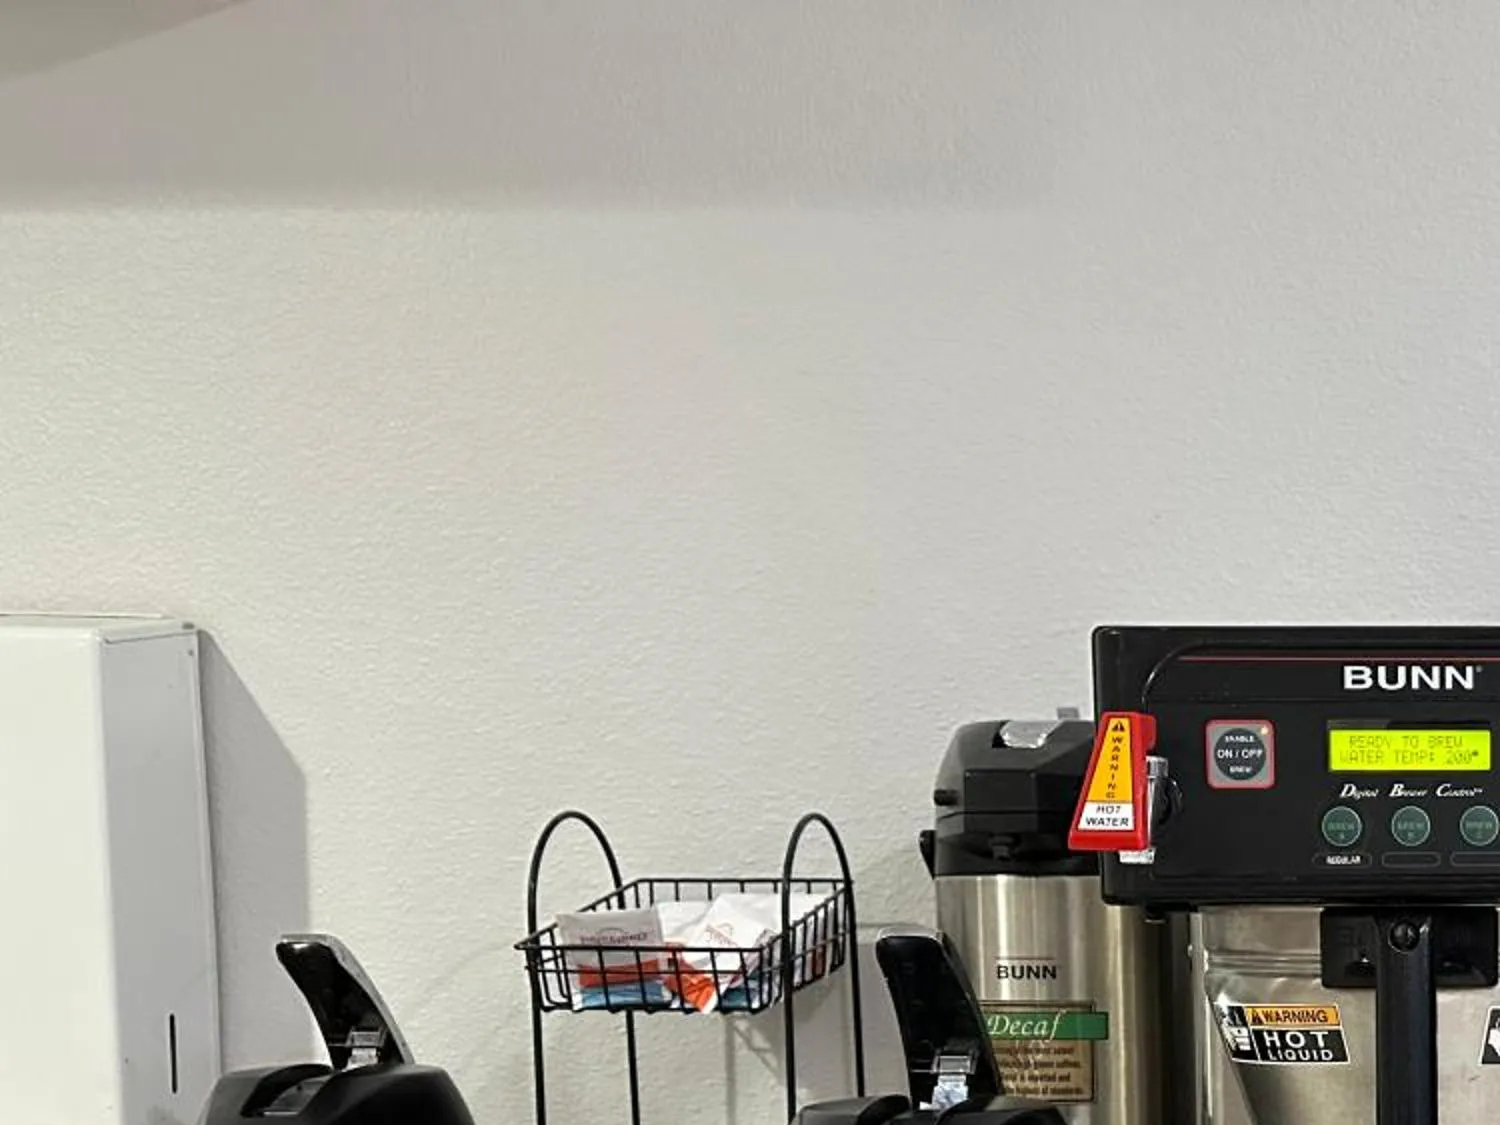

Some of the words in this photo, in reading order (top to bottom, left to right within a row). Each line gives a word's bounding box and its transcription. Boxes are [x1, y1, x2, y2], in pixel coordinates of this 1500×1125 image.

[1343, 665, 1474, 690] BUNN
[1349, 735, 1392, 749] READY
[1401, 735, 1419, 749] TO
[1427, 735, 1463, 749] BREW
[1217, 749, 1233, 758] ON
[1241, 749, 1263, 758] OFF
[1339, 750, 1384, 765] WATER
[1393, 750, 1435, 765] TEMP:
[1105, 736, 1124, 799] WARNING
[1339, 783, 1379, 800] Digital
[1389, 783, 1428, 798] Brewer
[1095, 805, 1121, 814] HOT
[1085, 817, 1129, 827] WATER
[1326, 855, 1361, 865] REGULAR
[996, 964, 1058, 980] BUNN
[1261, 1009, 1329, 1023] WARNING
[986, 1009, 1067, 1041] Decaf
[1263, 1031, 1329, 1049] HOT
[1267, 1049, 1334, 1061] LIQUID
